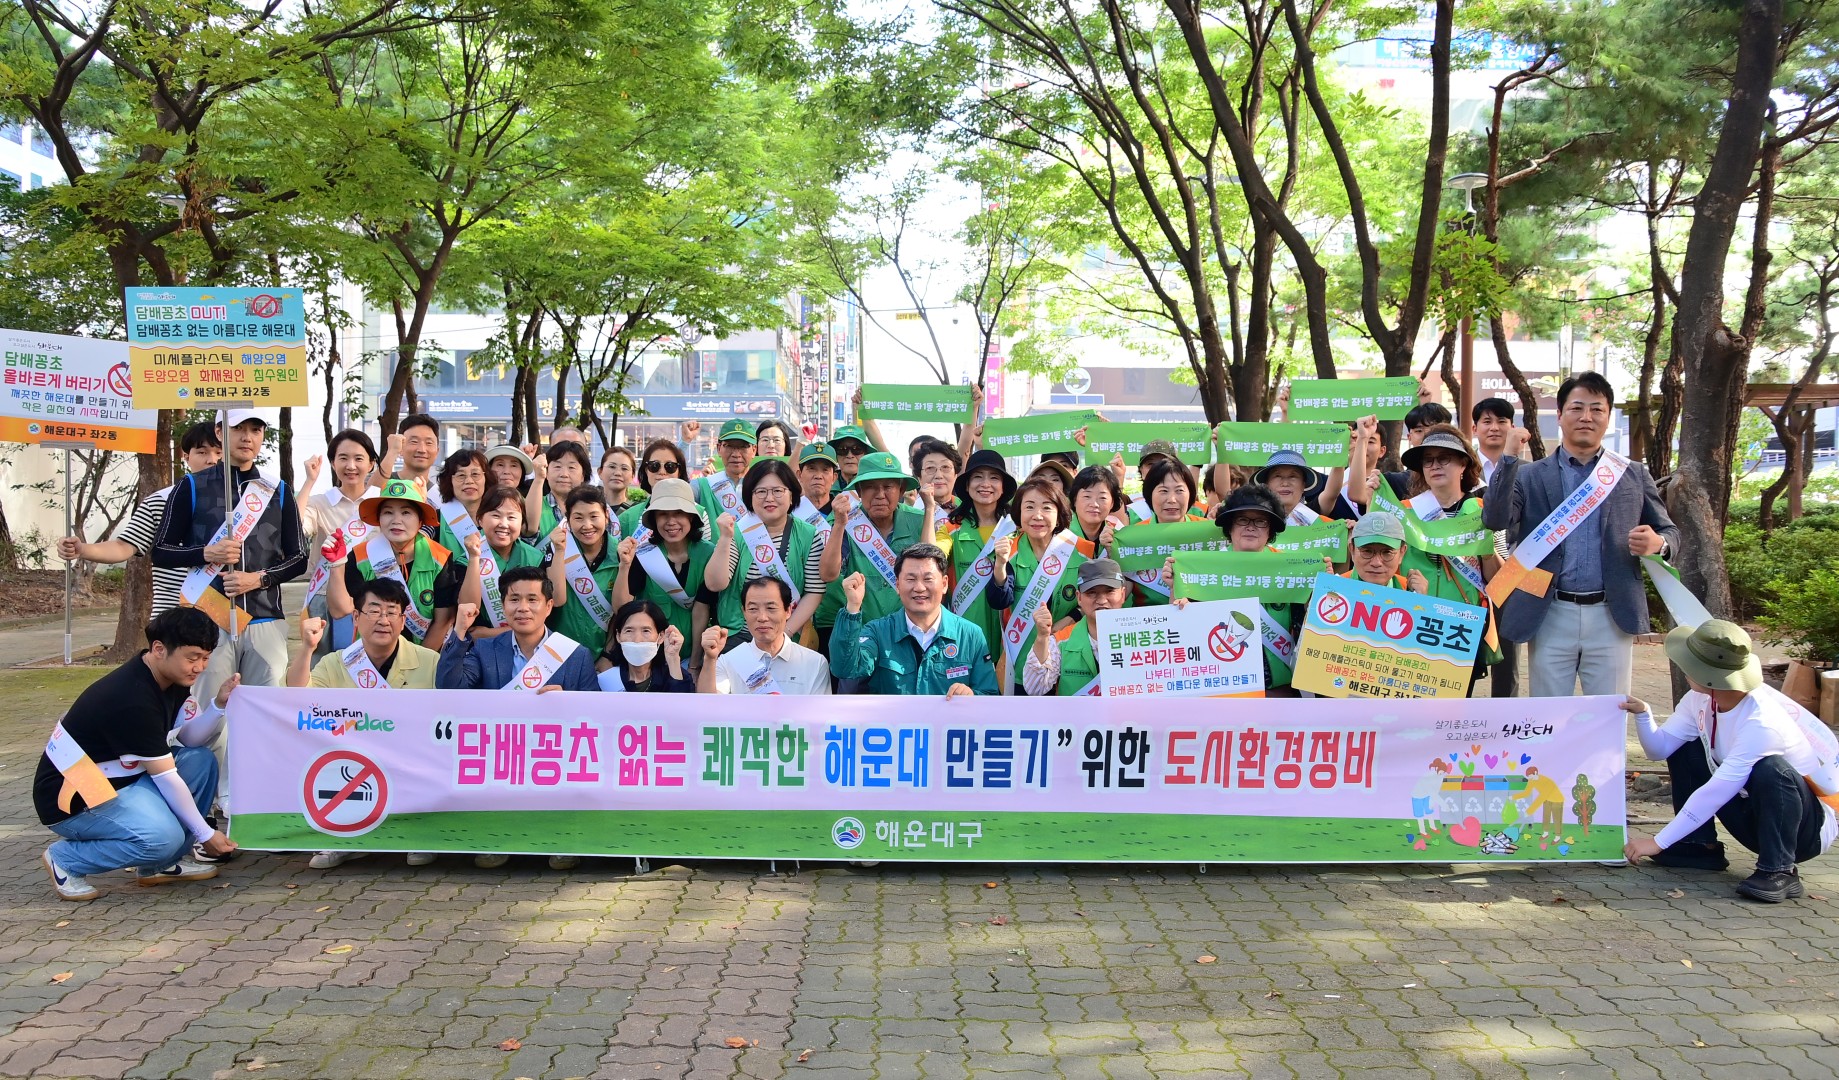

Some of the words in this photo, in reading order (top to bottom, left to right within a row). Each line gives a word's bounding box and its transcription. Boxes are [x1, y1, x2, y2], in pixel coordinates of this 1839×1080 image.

[135, 306, 188, 321] 담배꽁초
[190, 306, 228, 321] OUT!
[136, 324, 184, 338] 담배꽁초
[187, 324, 210, 338] 없는
[213, 323, 259, 338] 아름다운
[262, 323, 296, 337] 해운대
[5, 351, 63, 371] 담배꽁초
[154, 353, 233, 366] 미세플라스틱
[241, 353, 287, 365] 해양오염
[3, 368, 62, 389] 올바르게
[65, 375, 106, 394] 버리기
[143, 369, 190, 383] 토양오염
[199, 369, 245, 383] 화재원인
[253, 368, 299, 382] 침수원인
[10, 388, 41, 401] 깨끗한
[44, 392, 84, 405] 해운대를
[88, 396, 118, 408] 만들기
[121, 399, 134, 410] 위
[193, 387, 238, 398] 해운대구
[241, 386, 271, 397] 좌2동
[22, 401, 42, 413] 작은
[46, 404, 75, 416] 실천의
[79, 407, 129, 421] 시작입니다
[863, 400, 895, 411] 담배꽁초
[896, 401, 912, 411] 없는
[914, 402, 934, 412] 좌1동
[936, 401, 968, 413] 청결맛집
[1293, 397, 1328, 409] 담배꽁초
[1331, 397, 1349, 408] 없는
[1352, 397, 1374, 407] 좌1동
[1376, 395, 1413, 407] 청결맛집
[44, 424, 87, 438] 해운대구
[90, 429, 118, 441] 좌2동
[988, 435, 1021, 447] 담배꽁초
[1022, 433, 1039, 444] 없는
[1041, 430, 1061, 441] 좌1동
[1091, 442, 1125, 453] 담배꽁초
[1224, 440, 1259, 452] 담배꽁초
[1261, 442, 1279, 453] 없는
[1307, 442, 1343, 454] 청결맛집
[1567, 486, 1606, 525] 담배꽁초
[1302, 537, 1341, 550] 청결맛집
[1447, 530, 1485, 547] 청결맛집
[1545, 524, 1568, 545] 없는
[1117, 544, 1154, 559] 담배꽁초
[1180, 571, 1218, 586] 담배꽁초
[1221, 574, 1242, 587] 없는
[1245, 575, 1271, 589] 좌1동
[1274, 575, 1316, 590] 청결맛집
[1017, 574, 1051, 620] 담배꽁초
[1143, 616, 1168, 625] 해운대
[1350, 602, 1414, 640] NO
[1416, 616, 1473, 653] 꽁초
[1007, 619, 1028, 645] NO
[1109, 629, 1180, 649] 담배꽁초는
[1110, 653, 1124, 668] 꼭
[1130, 646, 1201, 667] 쓰레기통에
[1342, 644, 1367, 657] 바다로
[1369, 648, 1394, 663] 흘러간
[1395, 656, 1431, 671] 담배꽁초!
[1145, 667, 1175, 680] 나부터!
[1181, 665, 1220, 677] 지금부터!
[1305, 647, 1321, 658] 해양
[1322, 651, 1373, 671] 미세플라스틱이
[1375, 660, 1390, 673] 되어
[1391, 666, 1414, 680] 물고기
[1416, 672, 1438, 685] 먹이가
[1439, 678, 1462, 691] 됩니다
[1109, 684, 1143, 696] 담배꽁초
[1147, 683, 1164, 693] 없는
[1167, 679, 1201, 691] 아름다운
[1204, 676, 1229, 688] 해운대
[1233, 673, 1258, 685] 만들기
[1325, 663, 1357, 677] 담배꽁초
[1359, 671, 1376, 682] 없는
[1378, 675, 1410, 690] 아름다운
[1412, 683, 1437, 696] 해운대
[1348, 680, 1391, 698] 해운대구
[313, 707, 363, 718] Sun&Fun
[297, 710, 395, 736] Haeundae
[1501, 722, 1554, 741] 해운대
[617, 724, 687, 787] 없는
[703, 723, 809, 787] 쾌적한
[824, 725, 930, 789] 해운대
[1082, 727, 1151, 789] 위한
[1164, 728, 1378, 789] 도시환경정비
[874, 819, 983, 849] 해운대구
